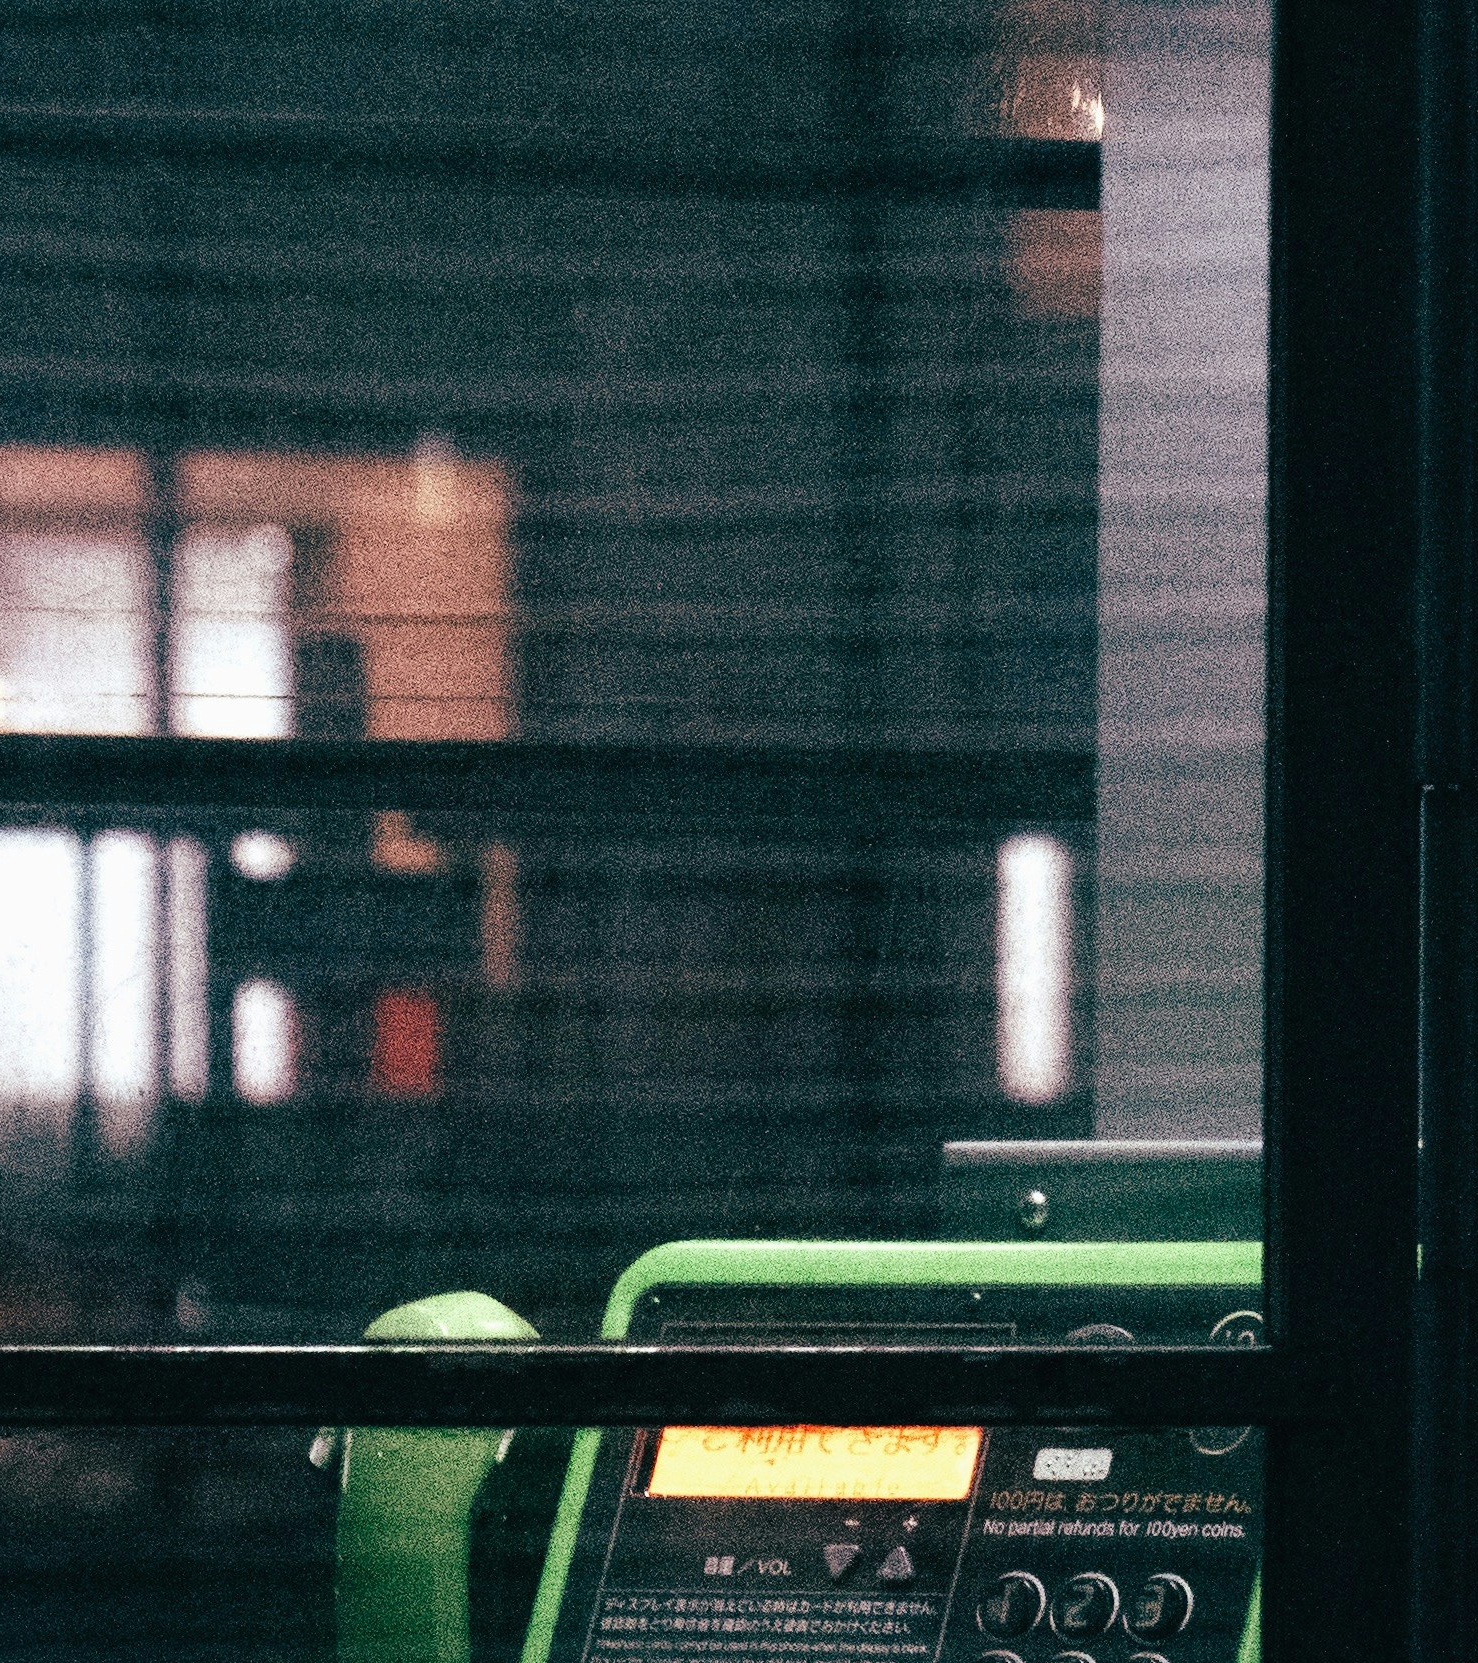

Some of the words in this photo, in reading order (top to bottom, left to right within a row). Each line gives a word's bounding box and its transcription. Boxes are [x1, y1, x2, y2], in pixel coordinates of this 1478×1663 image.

[983, 1518, 1004, 1535] No
[1007, 1519, 1054, 1537] partial
[1058, 1519, 1115, 1537] refunds
[1119, 1519, 1139, 1536] for
[1064, 1583, 1094, 1627] 2
[1135, 1584, 1165, 1628] 3
